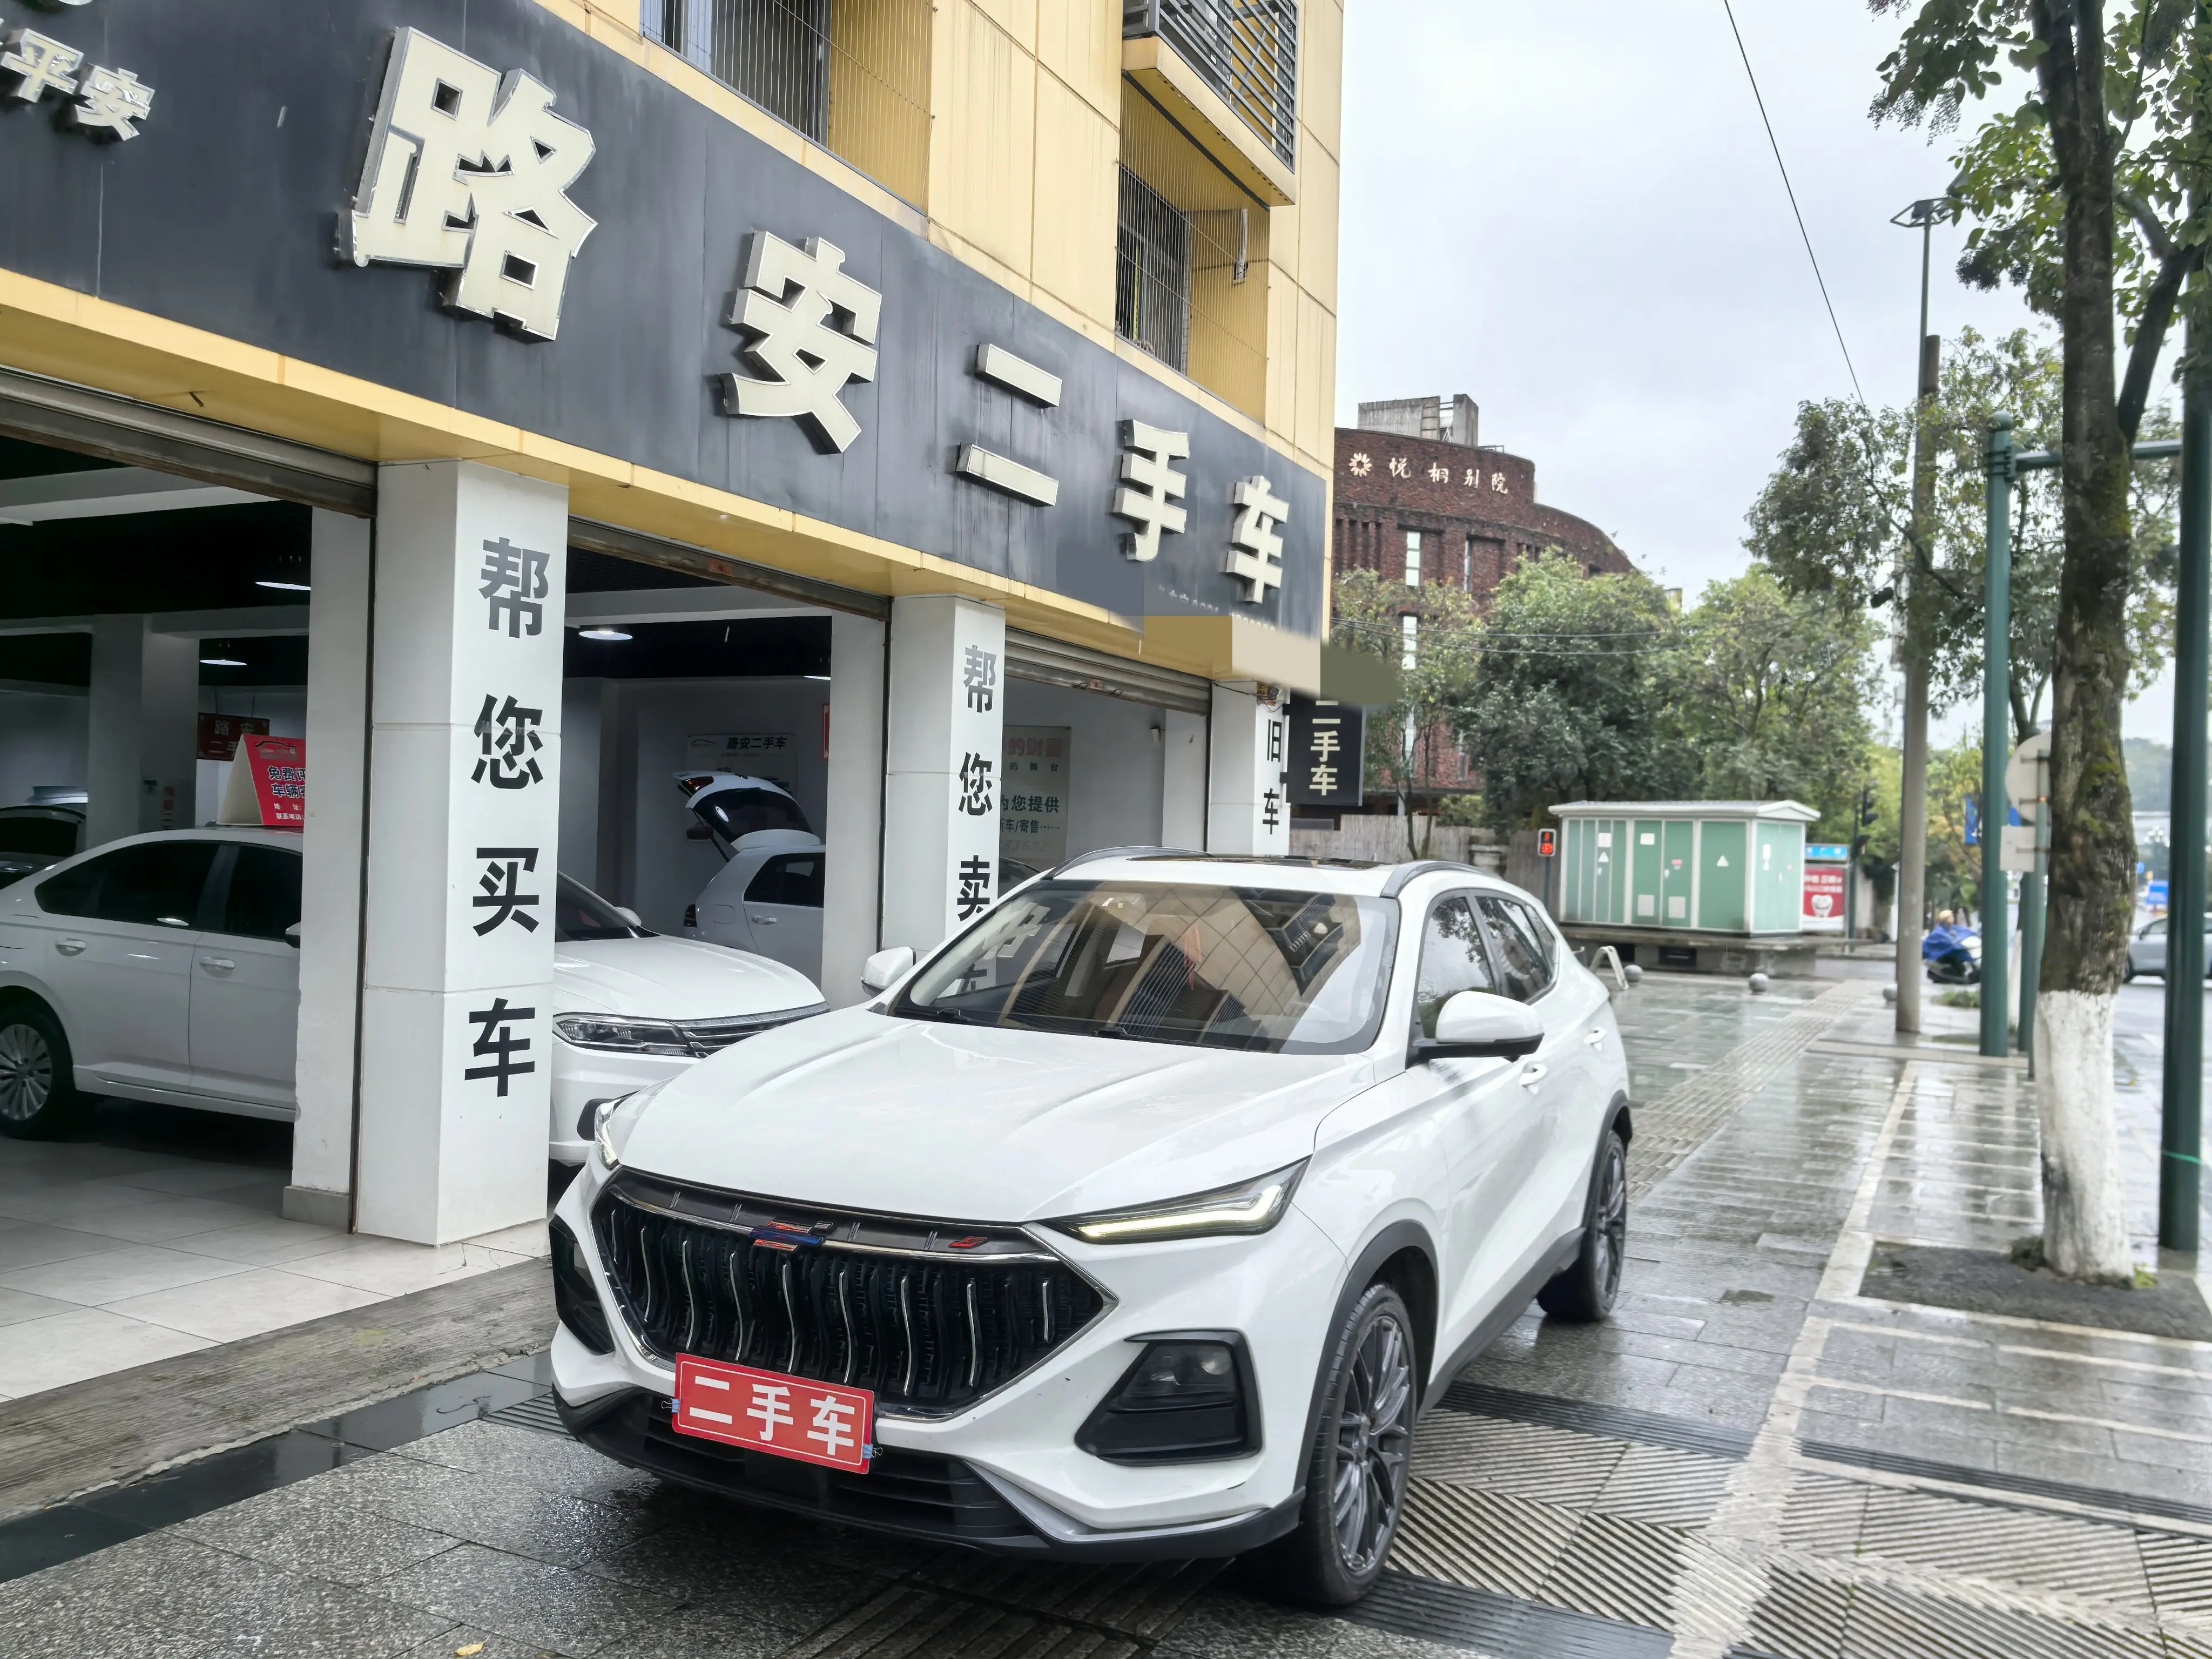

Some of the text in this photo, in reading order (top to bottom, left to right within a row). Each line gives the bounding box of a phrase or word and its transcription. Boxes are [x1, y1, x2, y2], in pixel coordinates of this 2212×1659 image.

[0, 18, 156, 141] 平安
[346, 26, 1290, 604] 路安二手车
[1389, 456, 1508, 494] 悦桐别院
[726, 736, 788, 750] 路安二手车
[1003, 736, 1062, 758] 的财富
[1309, 700, 1341, 795] 二手车
[464, 537, 550, 1097] 帮您买车
[689, 1375, 855, 1456] 二手车
